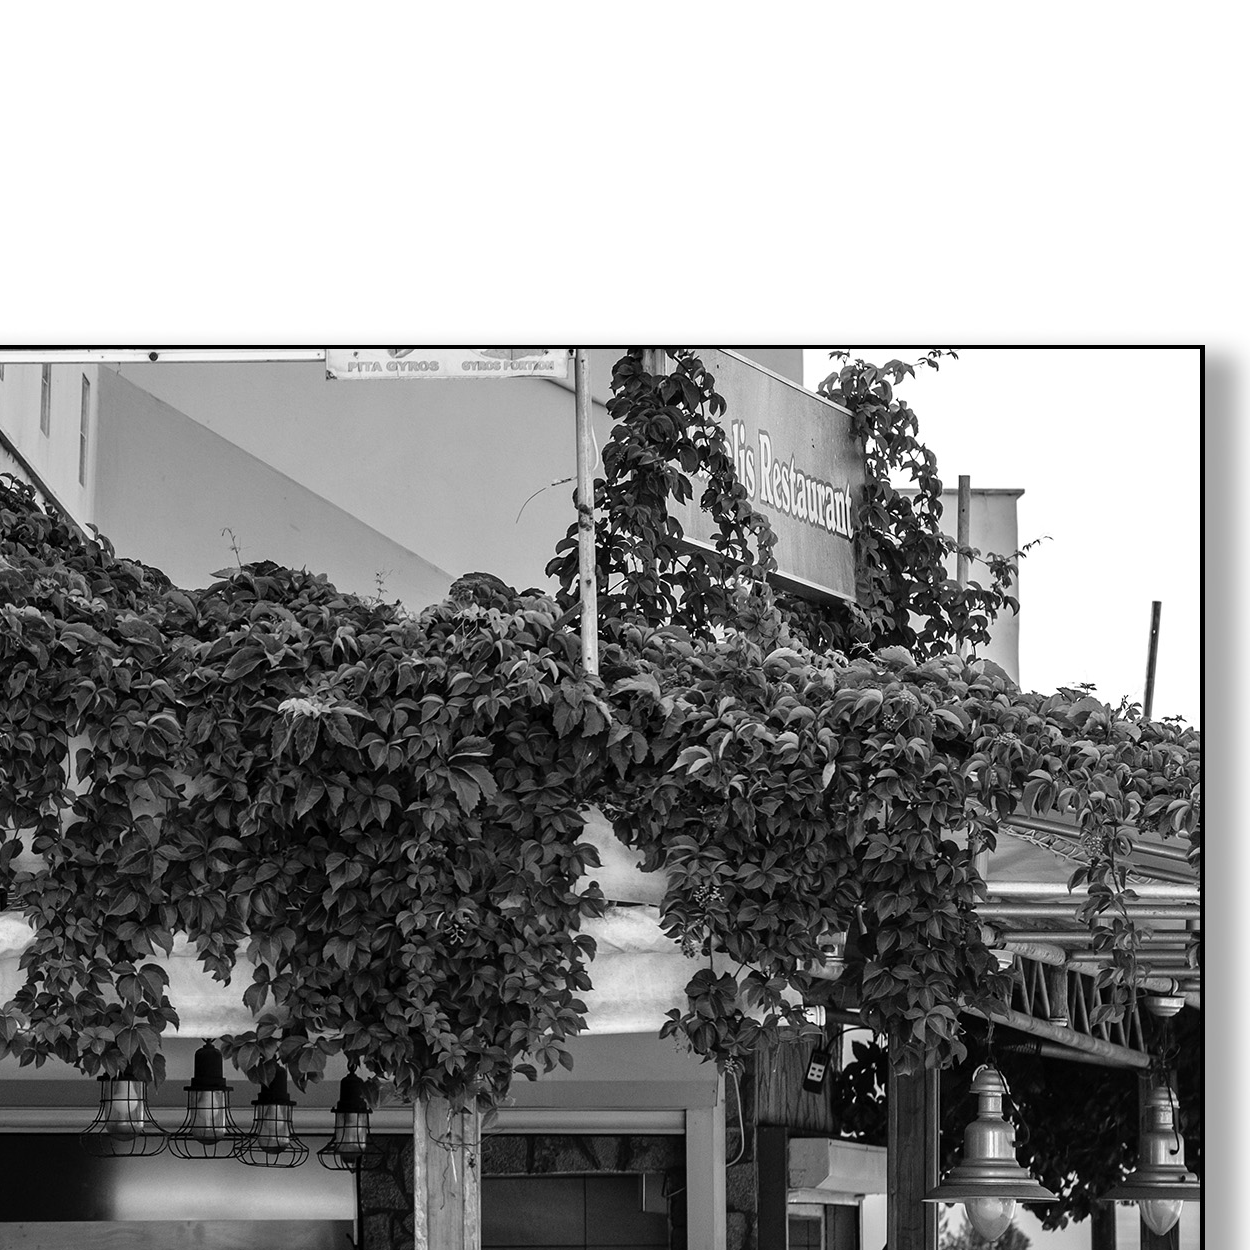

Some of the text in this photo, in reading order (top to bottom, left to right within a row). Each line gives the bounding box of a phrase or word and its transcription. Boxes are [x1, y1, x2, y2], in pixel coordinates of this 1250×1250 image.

[347, 361, 440, 372] PITA GYROS
[461, 361, 555, 371] GYROS PORTION
[758, 429, 854, 541] Restaurant
